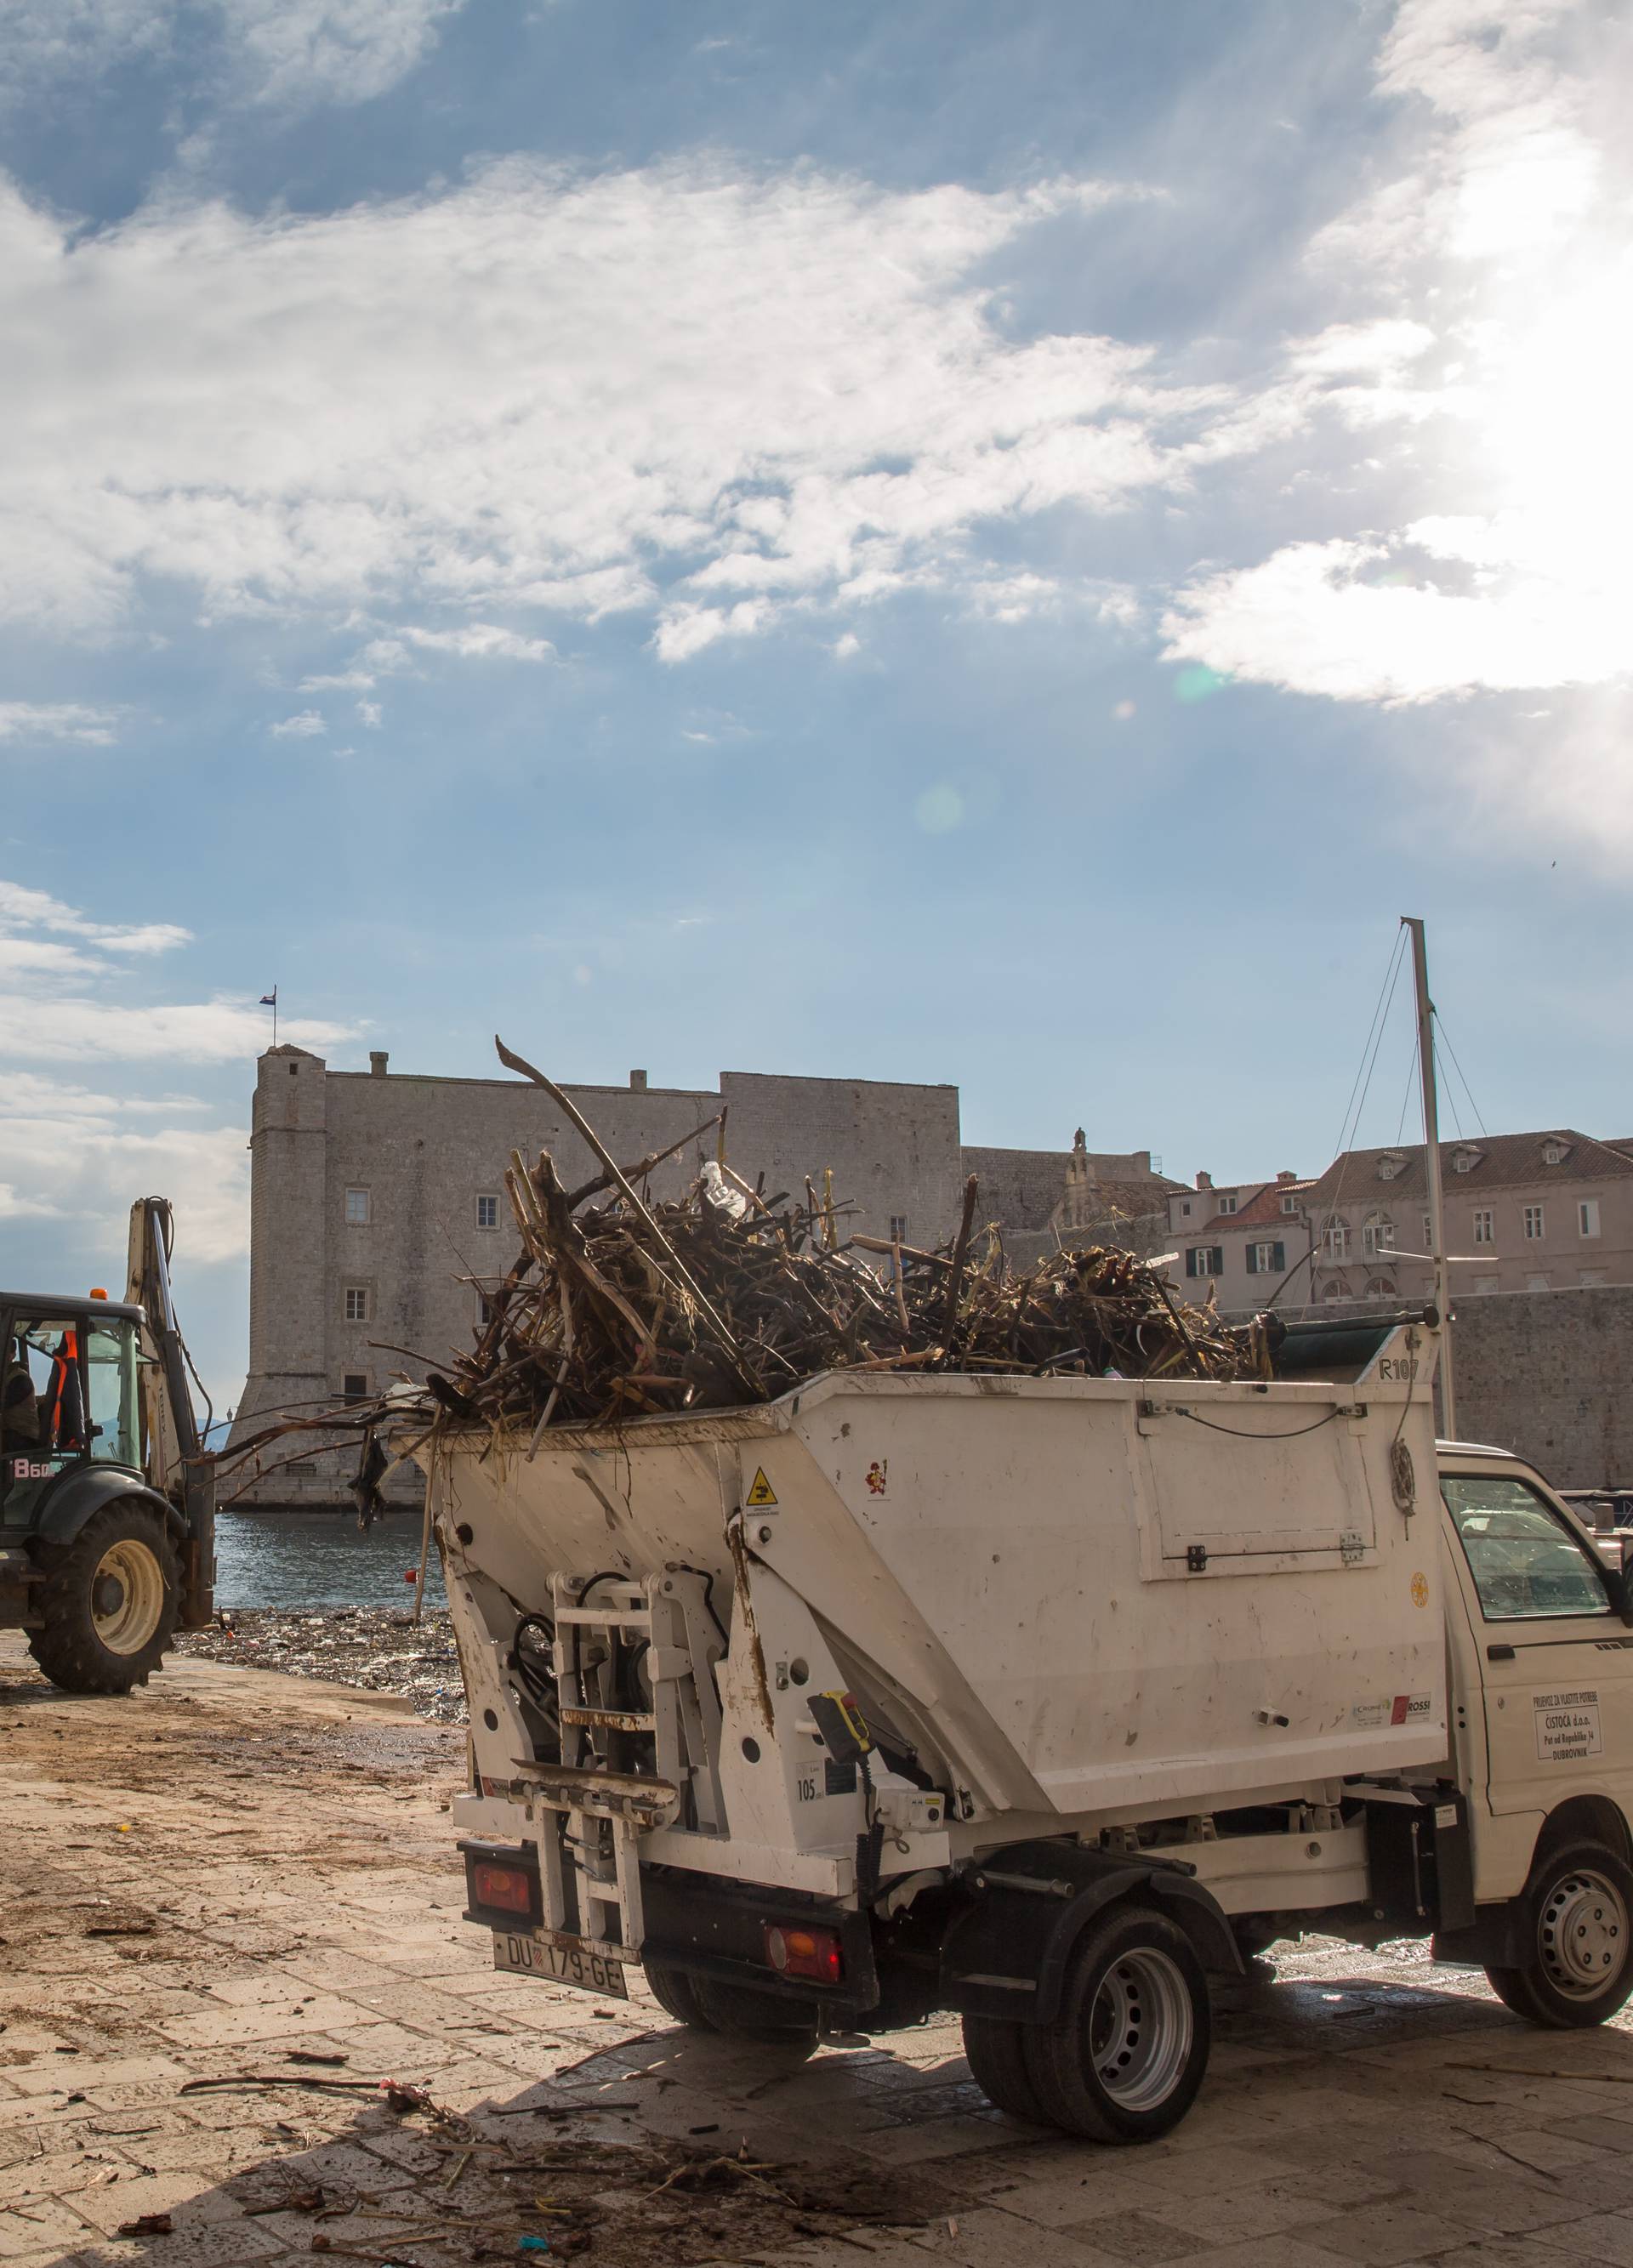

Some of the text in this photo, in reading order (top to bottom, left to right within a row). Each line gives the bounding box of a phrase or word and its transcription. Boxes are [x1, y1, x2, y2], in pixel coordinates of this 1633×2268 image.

[1380, 1358, 1420, 1380] R107
[1408, 1700, 1431, 1712] ROSSI
[1533, 1691, 1598, 1708] PRIJEVOZ ZA VLASTITE POTREBE
[1545, 1713, 1590, 1729] ČISTOĆA d.o.o.
[1545, 1735, 1553, 1745] Put
[1554, 1733, 1561, 1744] od
[1552, 1748, 1588, 1760] DUBROVNIK
[798, 1779, 815, 1801] 105
[508, 1935, 619, 1989] DU 179-GE
